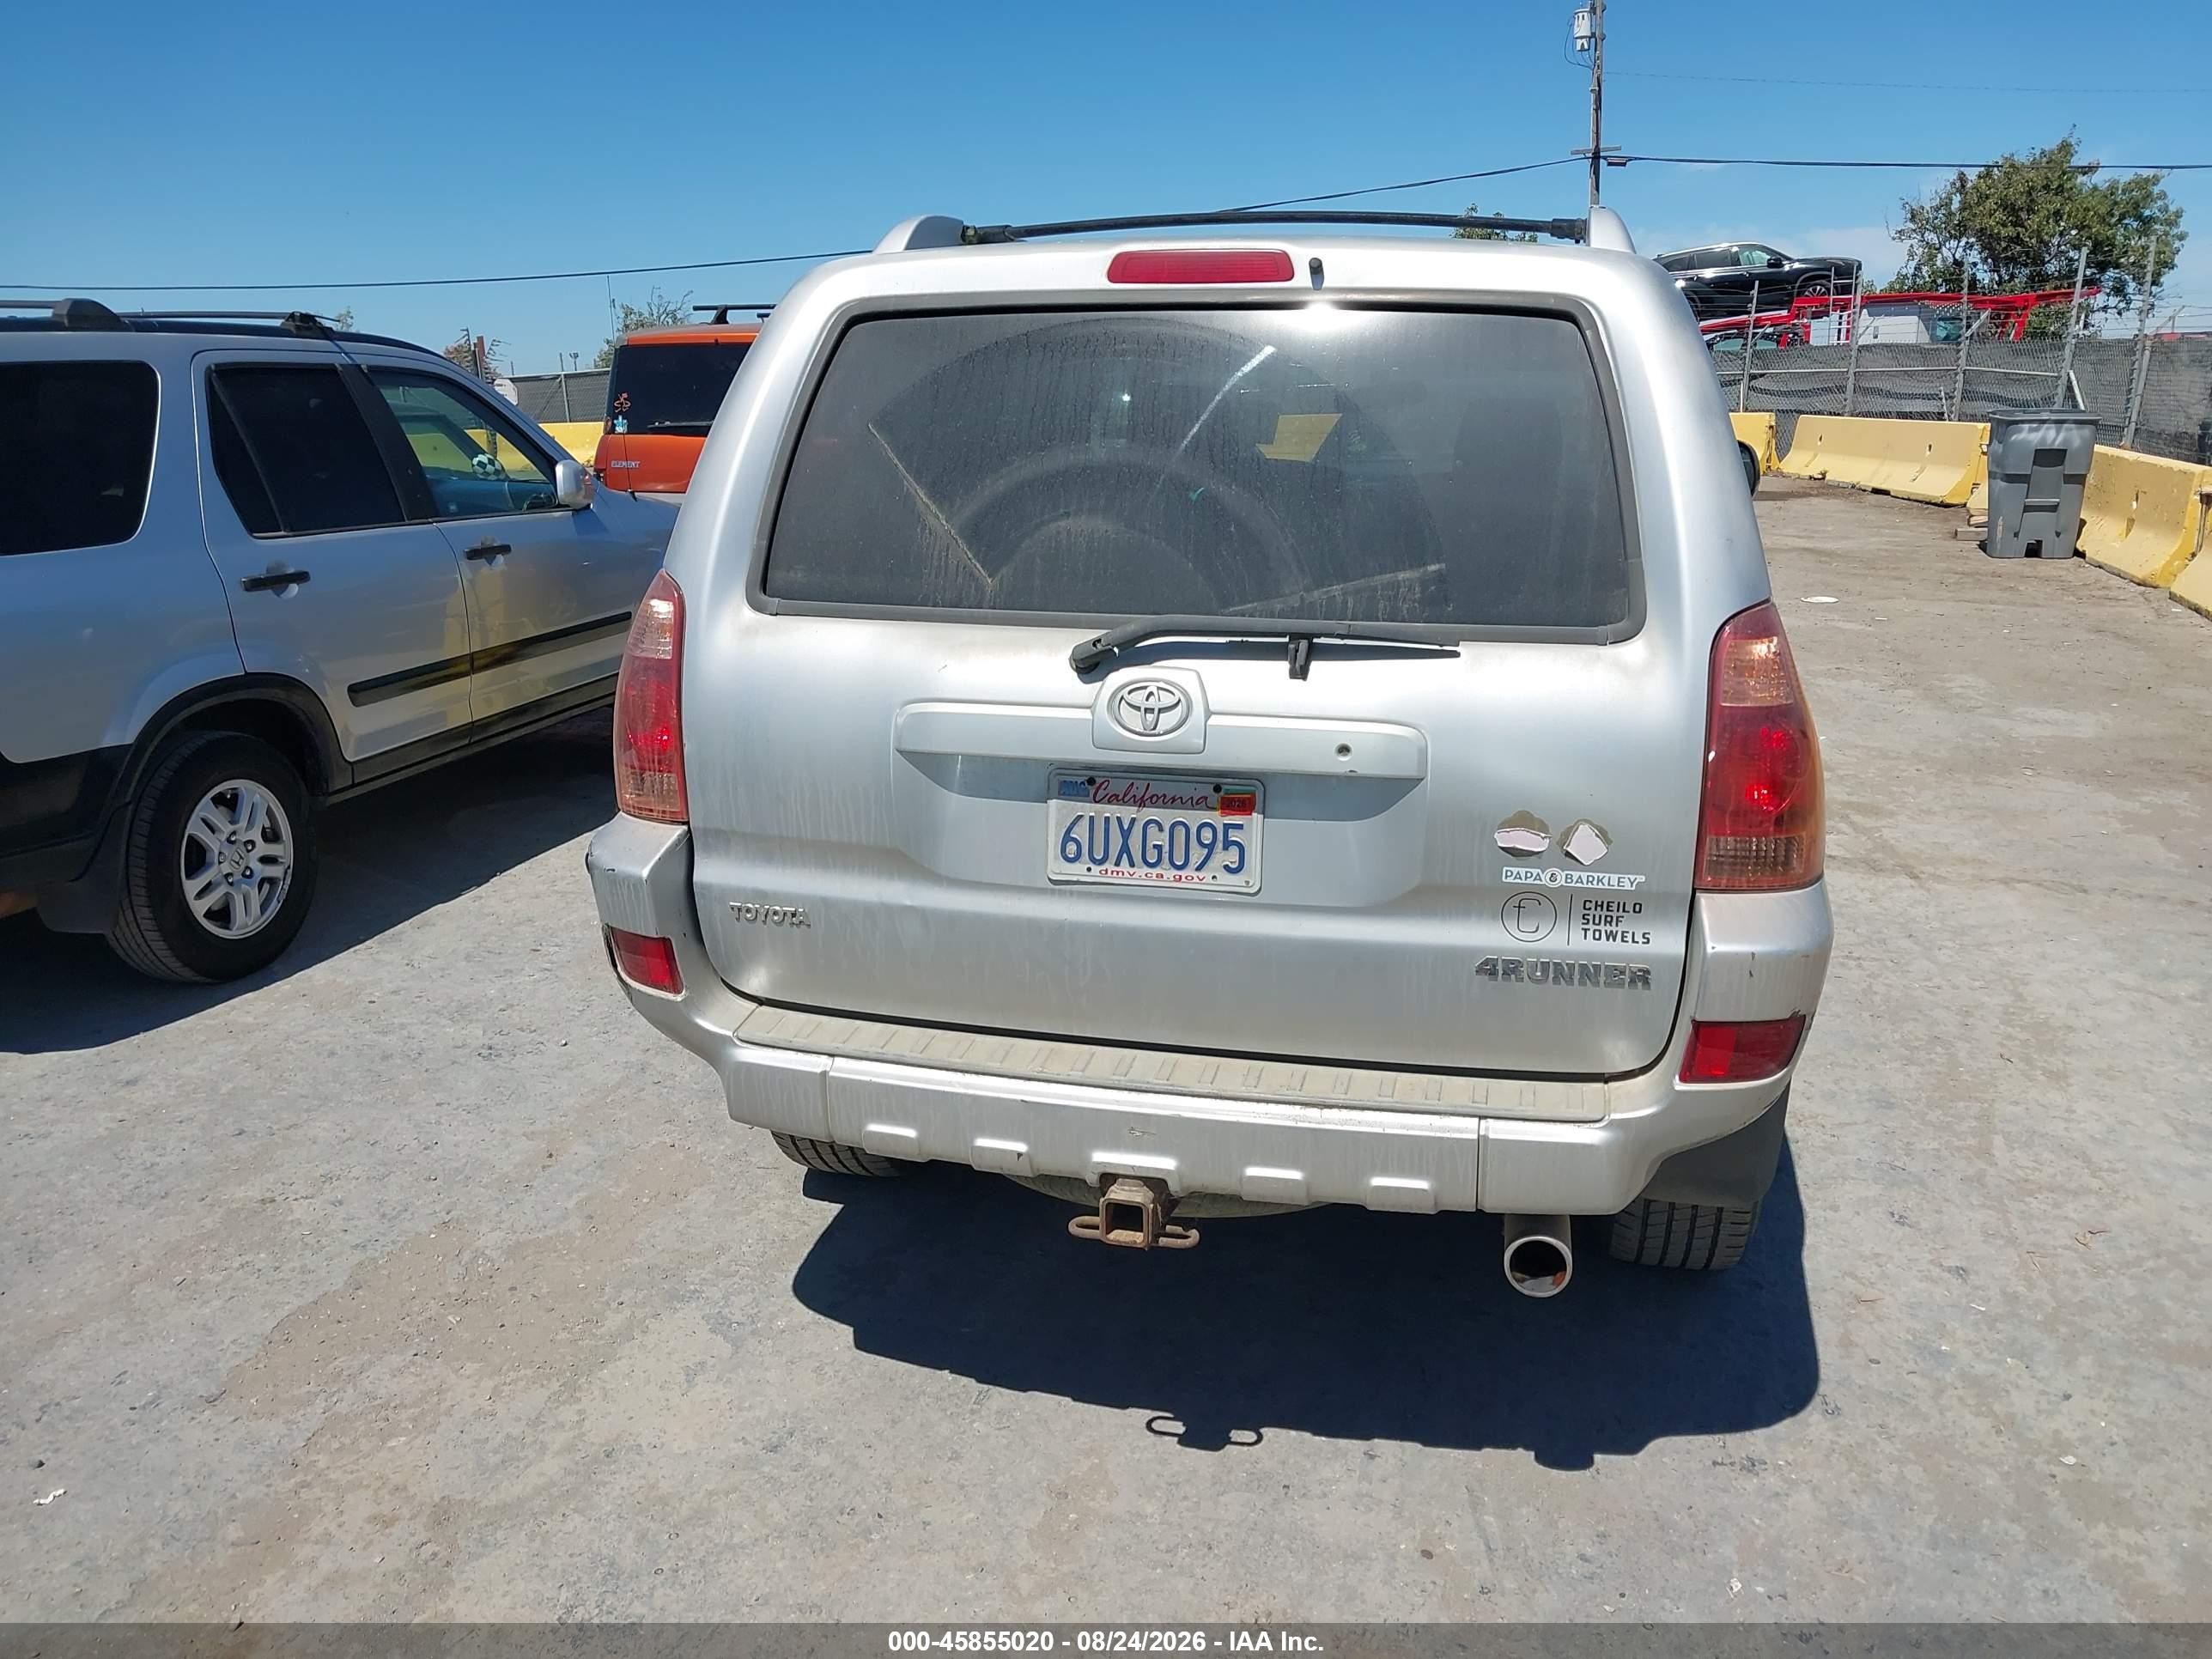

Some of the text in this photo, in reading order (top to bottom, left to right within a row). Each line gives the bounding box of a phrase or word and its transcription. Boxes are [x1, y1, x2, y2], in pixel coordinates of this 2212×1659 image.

[1092, 779, 1216, 811] California
[1060, 812, 1246, 874] 6UXG095
[1098, 867, 1206, 882] dmv.ca.gov
[1504, 870, 1543, 882] PAPA
[1564, 872, 1638, 888] BARKLEY
[728, 902, 811, 928] TOYOTA
[1583, 899, 1643, 915] CHEILO
[1581, 914, 1625, 928] SURF
[1581, 927, 1651, 945] TOWELS
[1475, 955, 1652, 990] 4RUNNER
